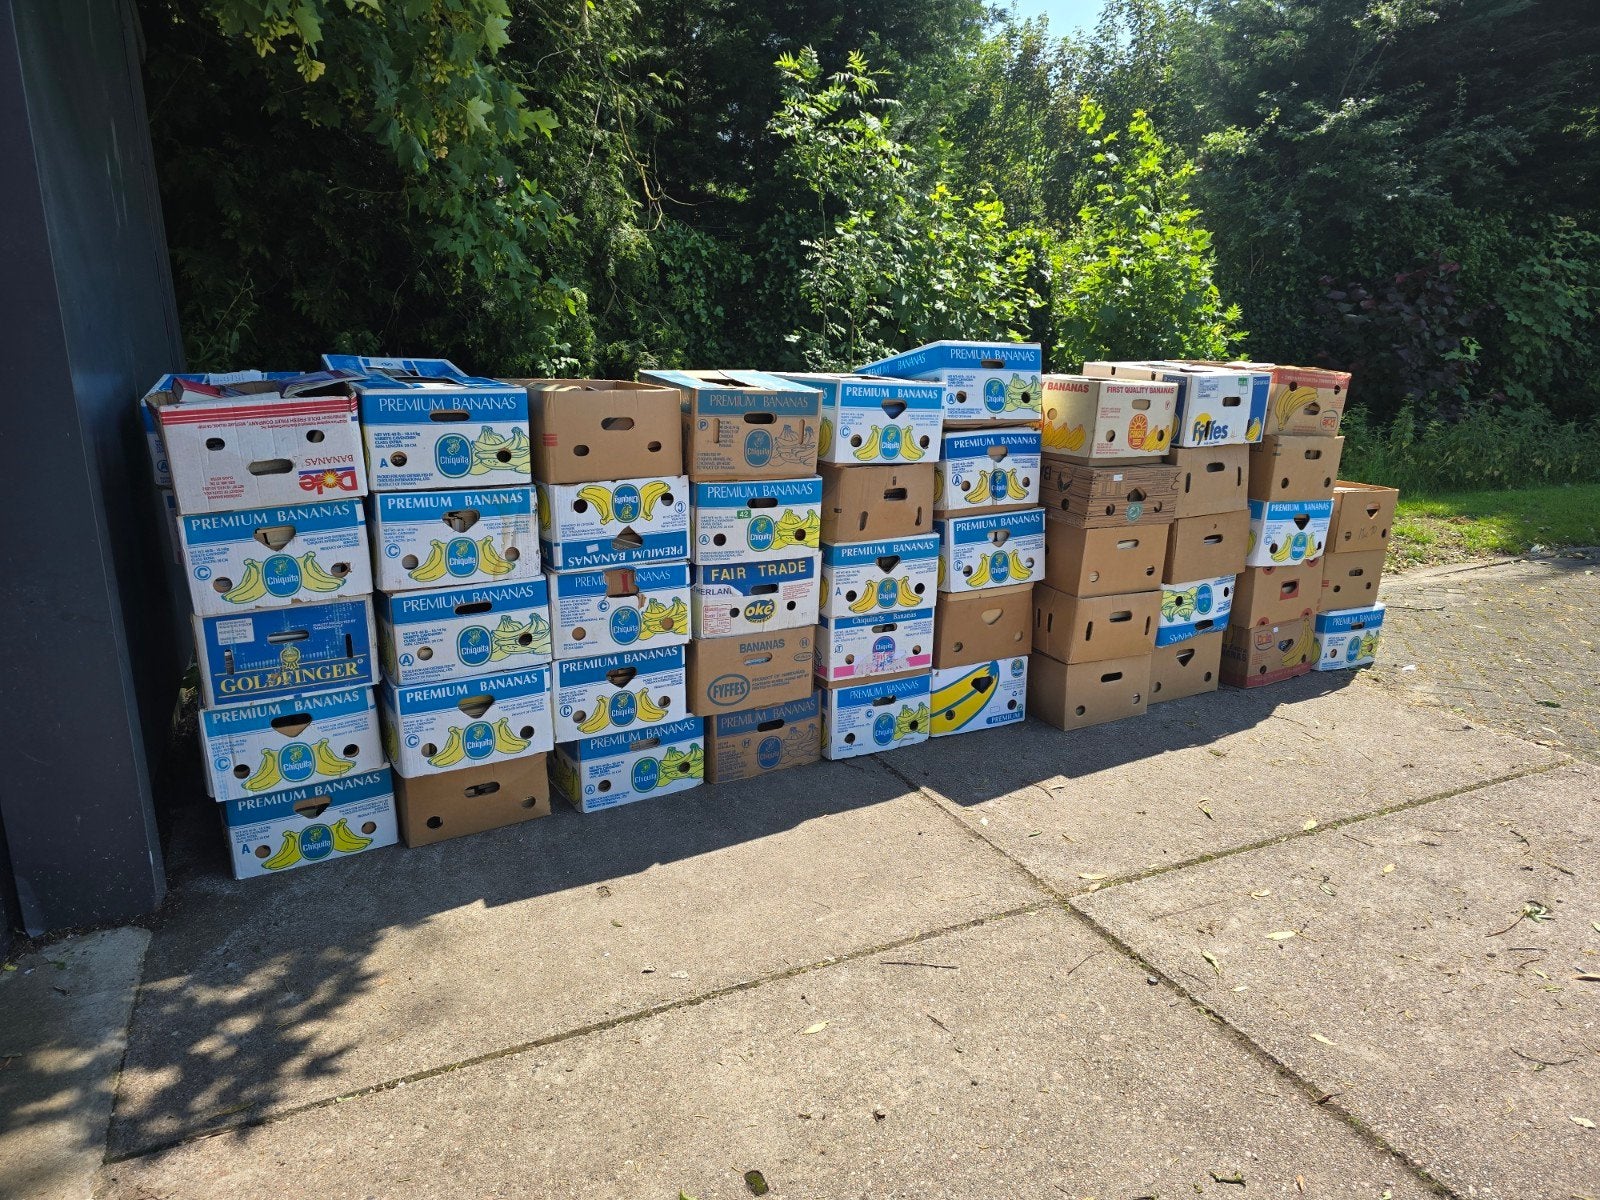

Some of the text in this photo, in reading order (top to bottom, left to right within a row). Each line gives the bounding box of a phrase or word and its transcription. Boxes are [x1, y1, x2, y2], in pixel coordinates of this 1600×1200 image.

[950, 349, 1035, 361] PREMIUM BANANAS
[846, 387, 938, 399] PREMIUM BANANAS
[1047, 382, 1090, 394] BANANAS
[1124, 386, 1149, 394] QUALITY
[379, 397, 516, 412] PREMIUM BANANAS
[710, 394, 808, 408] PREMIUM BANANAS
[954, 436, 1037, 449] PREMIUM BANANAS
[305, 454, 354, 466] BANANAS
[379, 457, 388, 468] A
[440, 455, 469, 467] Chiquita
[299, 469, 358, 494] Dole
[707, 483, 813, 499] PREMIUM BANANAS
[387, 491, 523, 510] PREMIUM BANANAS
[1271, 502, 1330, 512] PREMIUM BANANAS
[191, 503, 350, 531] PREMIUM BANANAS
[739, 511, 749, 519] 42
[956, 513, 1041, 532] PREMIUM BANANAS
[568, 545, 683, 567] PREMIUM BANANAS
[841, 541, 934, 557] PREMIUM BANANAS
[449, 557, 476, 567] Chiquita
[711, 560, 807, 581] FAIR TRADE
[267, 574, 299, 587] Chiquita
[835, 587, 842, 596] A
[403, 585, 534, 613] PREMIUM BANANAS
[612, 624, 639, 635] Chiquita
[461, 645, 489, 658] Chiquita
[739, 638, 785, 654] BANANAS
[562, 647, 678, 673] PREMIUM BANANAS
[220, 662, 360, 694] GOLDFINGER
[406, 673, 538, 703] PREMIUM BANANAS
[712, 681, 746, 699] FYFFES
[850, 680, 920, 700] PREMIUM BANANAS
[212, 690, 360, 724] PREMIUM BANANAS
[720, 711, 767, 729] PREMIUM
[773, 700, 816, 719] BANANAS
[590, 720, 695, 750] PREMIUM BANANAS
[466, 739, 493, 751] Chiquita
[283, 761, 313, 773] Chiquita
[238, 773, 381, 812] PREMIUM BANANAS
[241, 843, 251, 855] A
[302, 839, 331, 852] Chiquita
